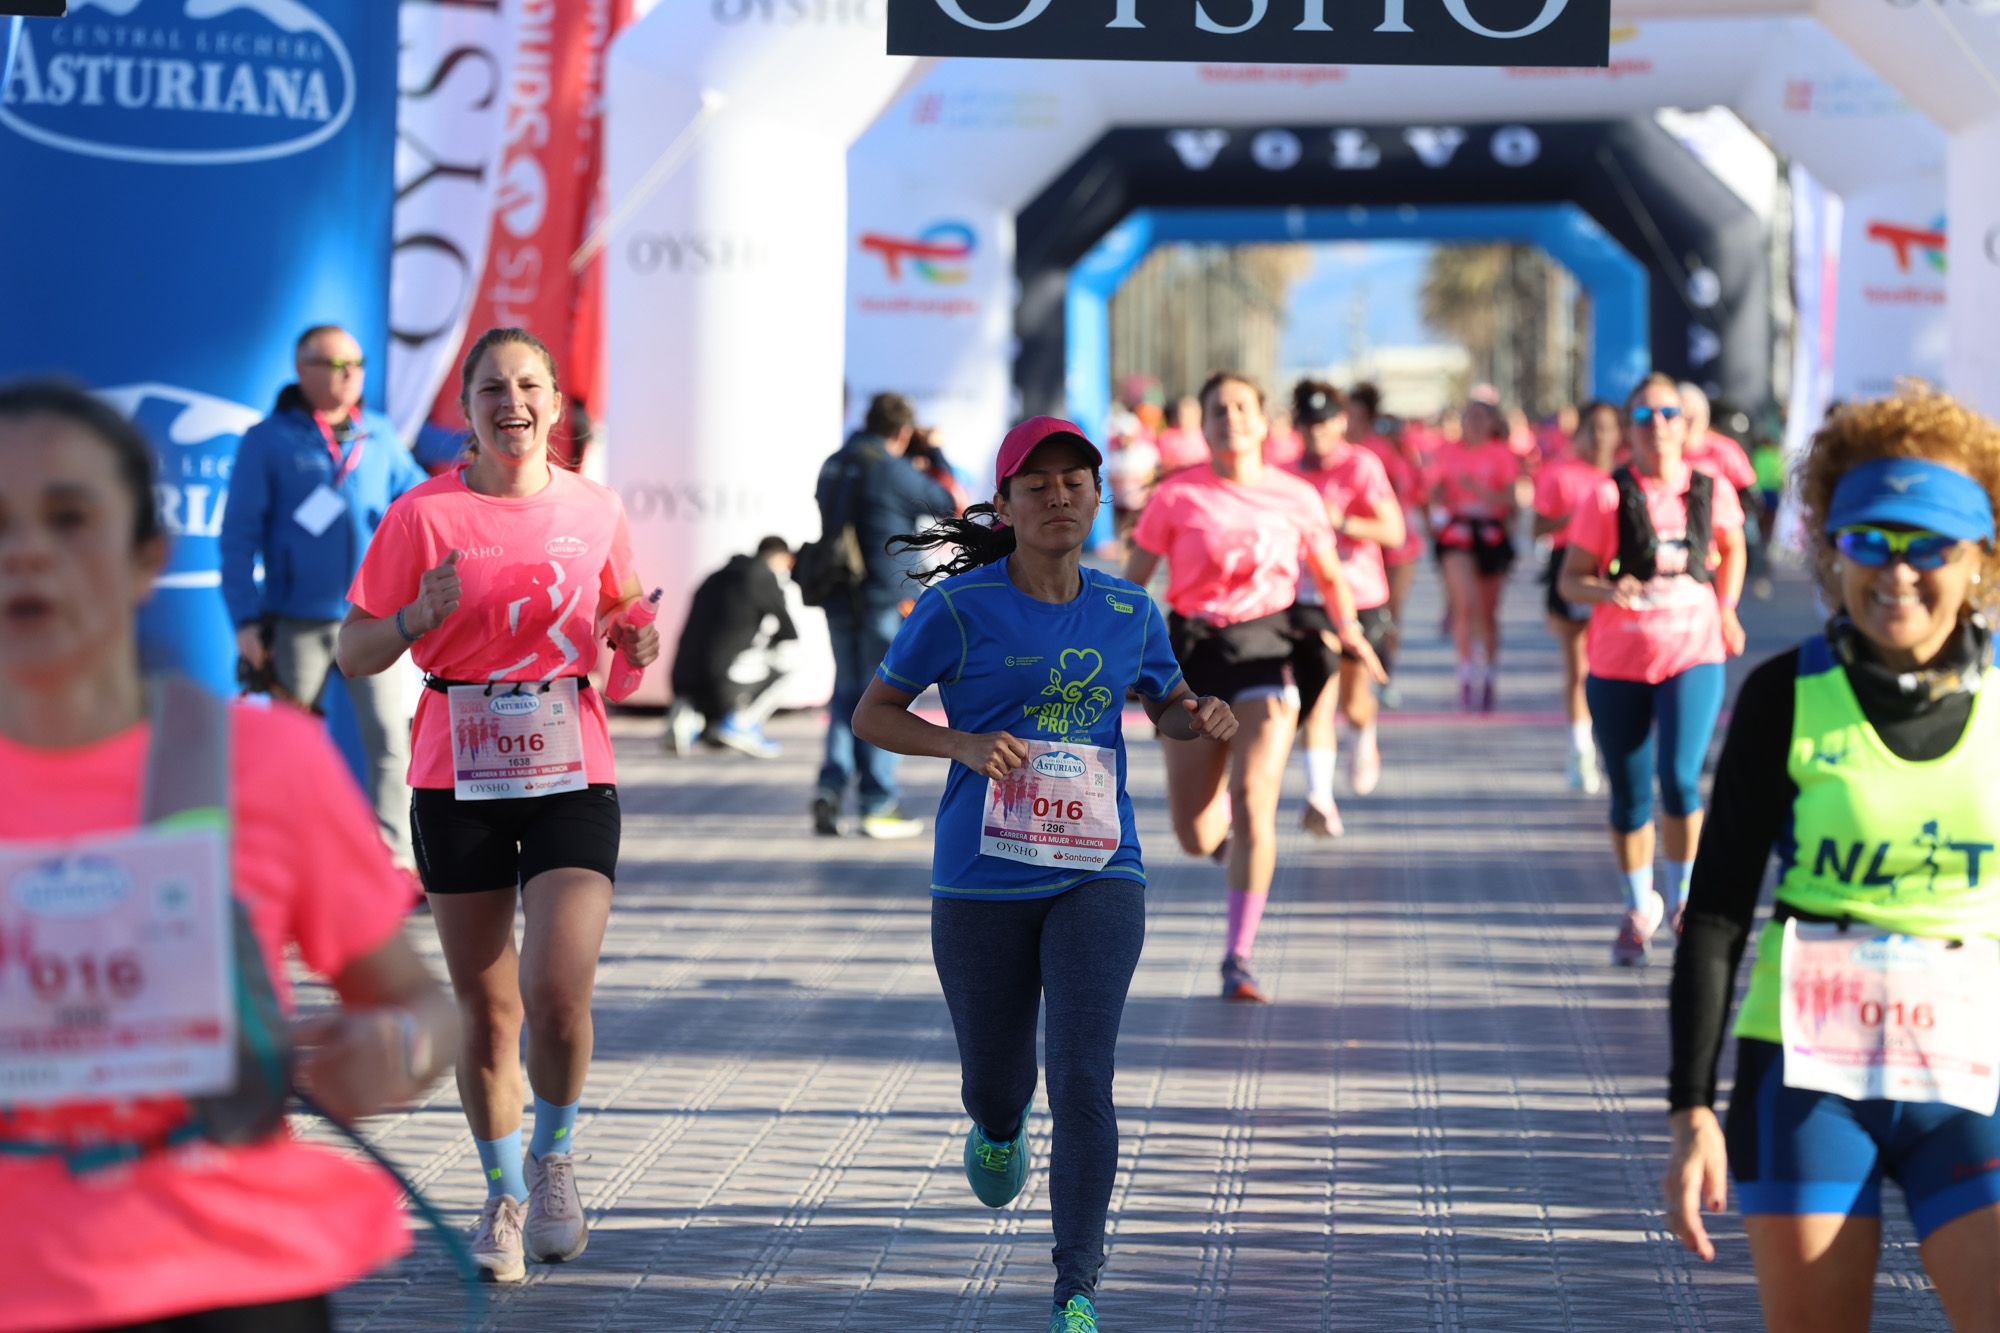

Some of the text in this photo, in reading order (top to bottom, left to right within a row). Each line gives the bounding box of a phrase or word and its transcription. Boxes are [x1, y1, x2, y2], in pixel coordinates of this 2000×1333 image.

[3, 26, 332, 122] ASTURIANA
[1166, 125, 1541, 170] VOLVO
[494, 700, 537, 711] ASTURIANA
[1041, 702, 1073, 720] SOY
[497, 733, 544, 754] 016
[509, 757, 530, 767] 1638
[1036, 758, 1082, 773] ASTURIANA
[470, 783, 510, 793] OYSHO
[1033, 797, 1083, 821] 016
[1041, 823, 1065, 833] 1296
[1000, 830, 1027, 840] CARRERA
[1048, 836, 1070, 844] MUJER
[1074, 839, 1104, 847] VALENCIA
[996, 842, 1105, 864] OYSHO Santander
[29, 948, 144, 998] 016
[1860, 1000, 1935, 1029] 016
